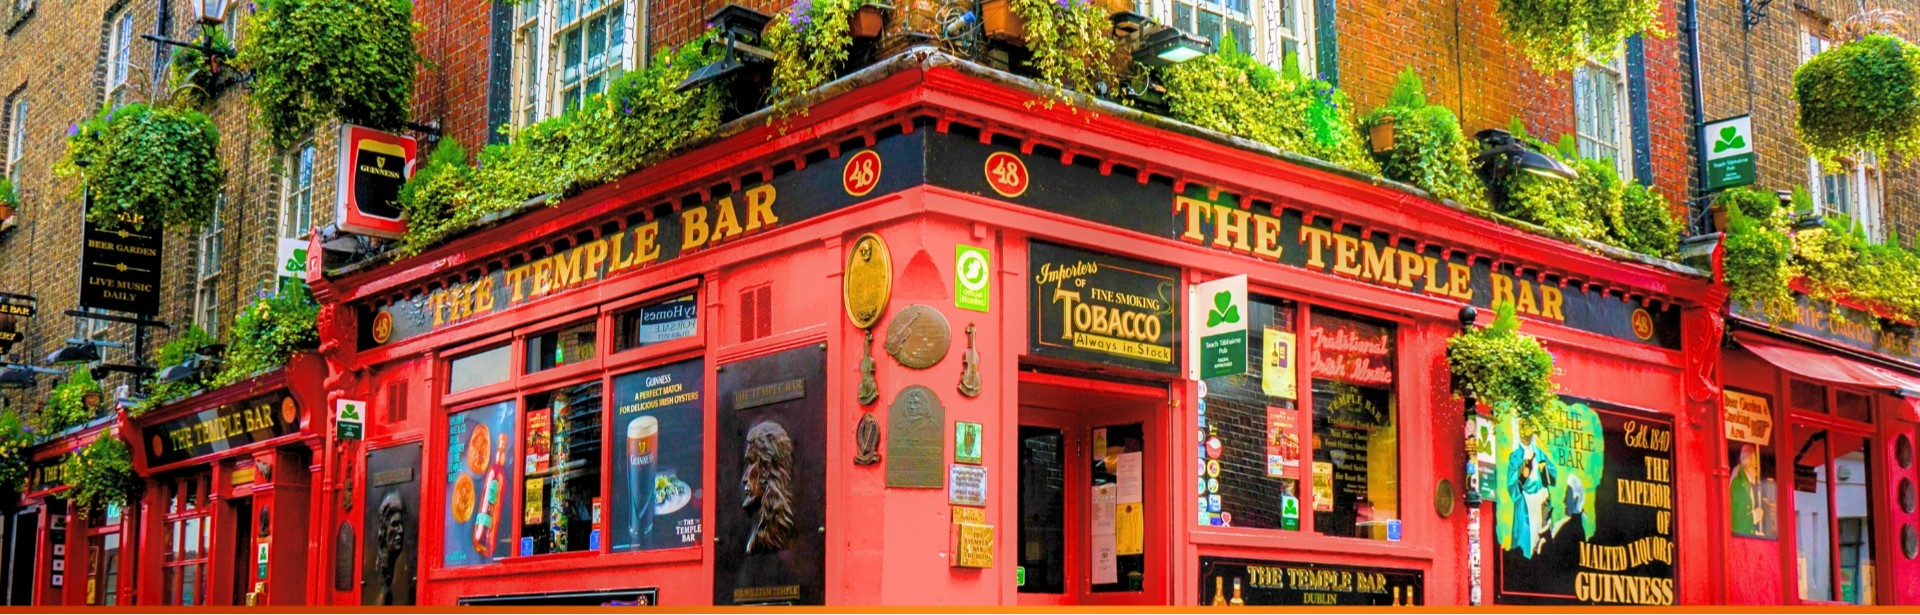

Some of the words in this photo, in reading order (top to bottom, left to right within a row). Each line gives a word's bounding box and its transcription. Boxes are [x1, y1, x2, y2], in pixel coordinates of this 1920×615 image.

[360, 165, 400, 179] GUINNESS
[848, 158, 873, 189] 48
[992, 158, 1020, 187] 48
[88, 239, 114, 251] BEER
[116, 243, 157, 257] GARDEN
[429, 276, 495, 327] THE
[507, 220, 661, 303] TEMPLE
[681, 183, 779, 251] BAR
[1175, 195, 1284, 259] THE
[1299, 223, 1474, 302] TEMPLE
[1490, 272, 1566, 324] BAR
[89, 276, 114, 288] LIVE
[117, 281, 152, 293] MUSIC
[1036, 259, 1098, 289] Importers
[1075, 278, 1087, 288] OF
[103, 290, 136, 302] DAILY
[1091, 287, 1114, 303] FINE
[1115, 291, 1160, 310] SMOKING
[9, 305, 30, 316] BAR
[1635, 304, 1649, 334] 48
[376, 317, 387, 338] 48
[1076, 332, 1118, 352] Always
[1122, 341, 1134, 354] in
[1137, 342, 1170, 360] Stock
[1218, 346, 1228, 354] Pub
[1310, 327, 1388, 355] Traditional
[1311, 350, 1346, 376] Irish
[1350, 357, 1393, 384] Music
[634, 392, 640, 401] A
[639, 388, 663, 400] PERFECT
[662, 383, 683, 395] MATCH
[645, 373, 672, 388] GUINNESS
[619, 405, 631, 415] FOR
[630, 399, 659, 413] DELICIOUS
[658, 396, 674, 406] IRISH
[674, 391, 699, 404] OYSTERS
[1327, 393, 1362, 414] TEMPLE
[1364, 400, 1381, 422] BAR
[169, 427, 193, 452] THE
[194, 411, 243, 446] TEMPLE
[243, 403, 274, 432] BAR
[1559, 411, 1582, 437] THE
[1731, 424, 1745, 440] Area
[1546, 427, 1595, 452] TEMPLE
[1650, 428, 1670, 452] 1840
[1557, 450, 1585, 471] BAR
[1645, 456, 1669, 482] THE
[1617, 478, 1672, 509] EMPEROR
[675, 524, 702, 536] TEMPLE
[683, 518, 695, 526] THE
[1656, 511, 1671, 535] OF
[681, 534, 695, 543] BAR
[1579, 541, 1628, 571] MALTED
[1628, 536, 1674, 568] LIQUORS
[1247, 565, 1283, 588] THE
[1286, 568, 1353, 592] TEMPLE
[1356, 571, 1388, 594] BAR
[1574, 571, 1674, 606] GUINNESS
[1303, 592, 1337, 605] DUBLIN
